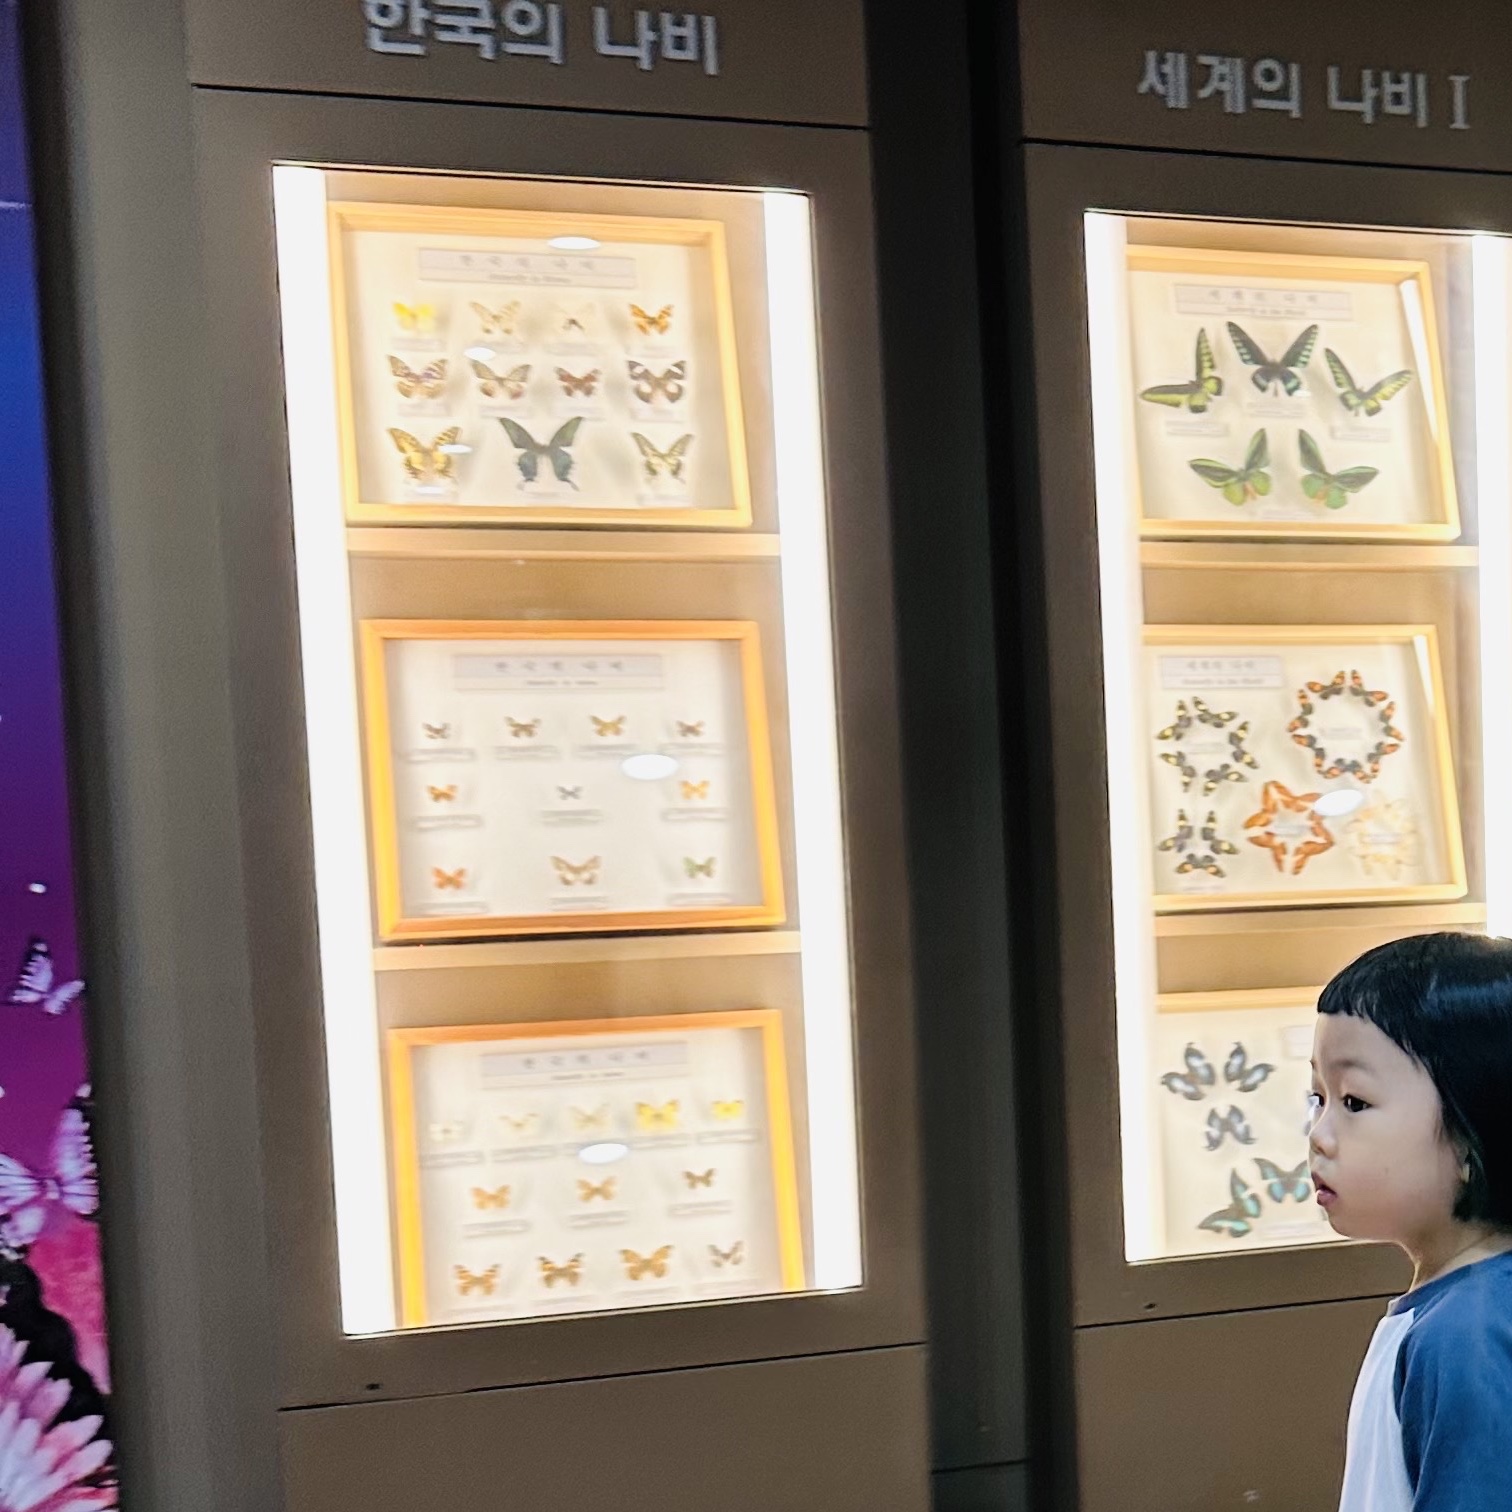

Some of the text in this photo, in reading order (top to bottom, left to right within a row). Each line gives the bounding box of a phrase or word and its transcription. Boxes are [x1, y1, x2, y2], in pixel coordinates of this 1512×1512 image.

[364, 0, 718, 76] 한국의 나비
[1137, 50, 1302, 118] 세계의
[1327, 64, 1430, 128] 나비
